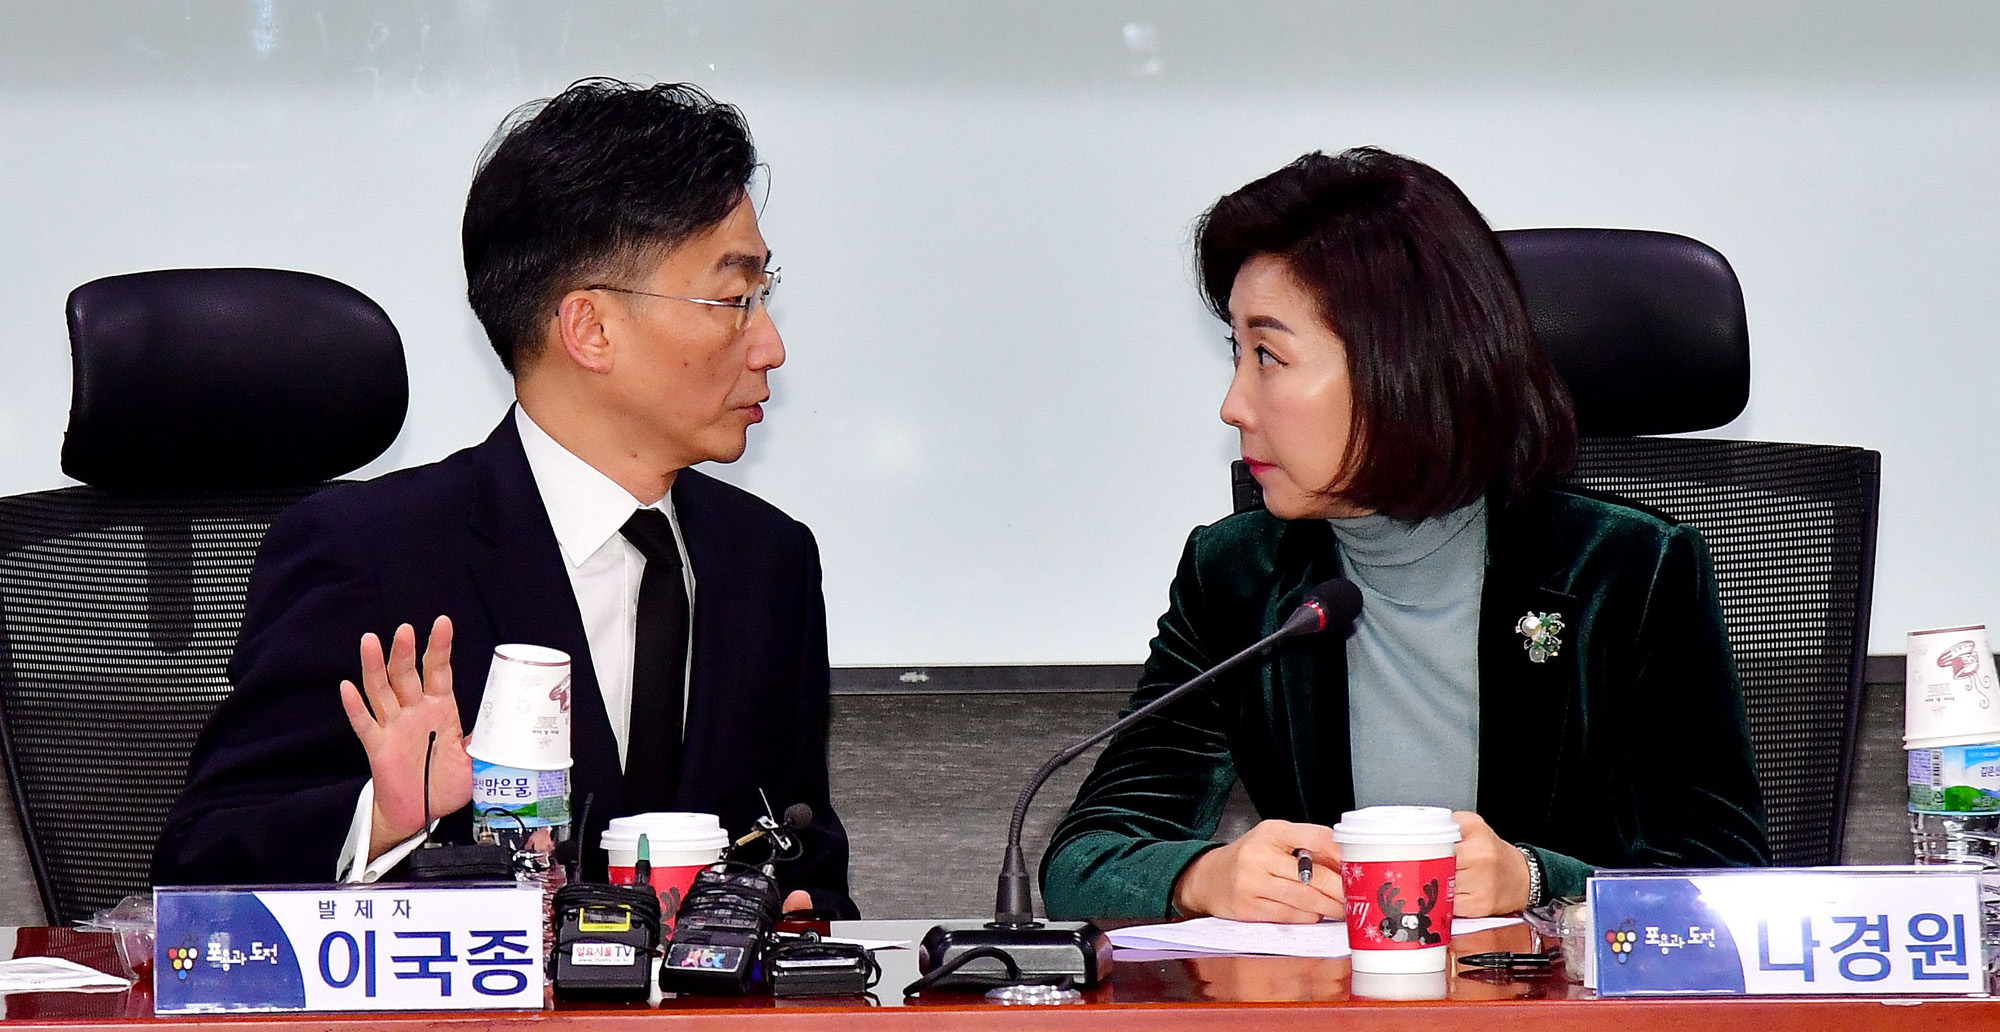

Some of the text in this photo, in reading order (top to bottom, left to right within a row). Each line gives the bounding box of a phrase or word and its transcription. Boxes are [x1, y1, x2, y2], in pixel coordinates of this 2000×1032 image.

[485, 777, 532, 798] 맑은물
[1644, 925, 1715, 954] 포용과 도전
[1757, 912, 1970, 983] 나경원
[206, 941, 278, 972] 포용과 도전
[318, 929, 534, 998] 이국종
